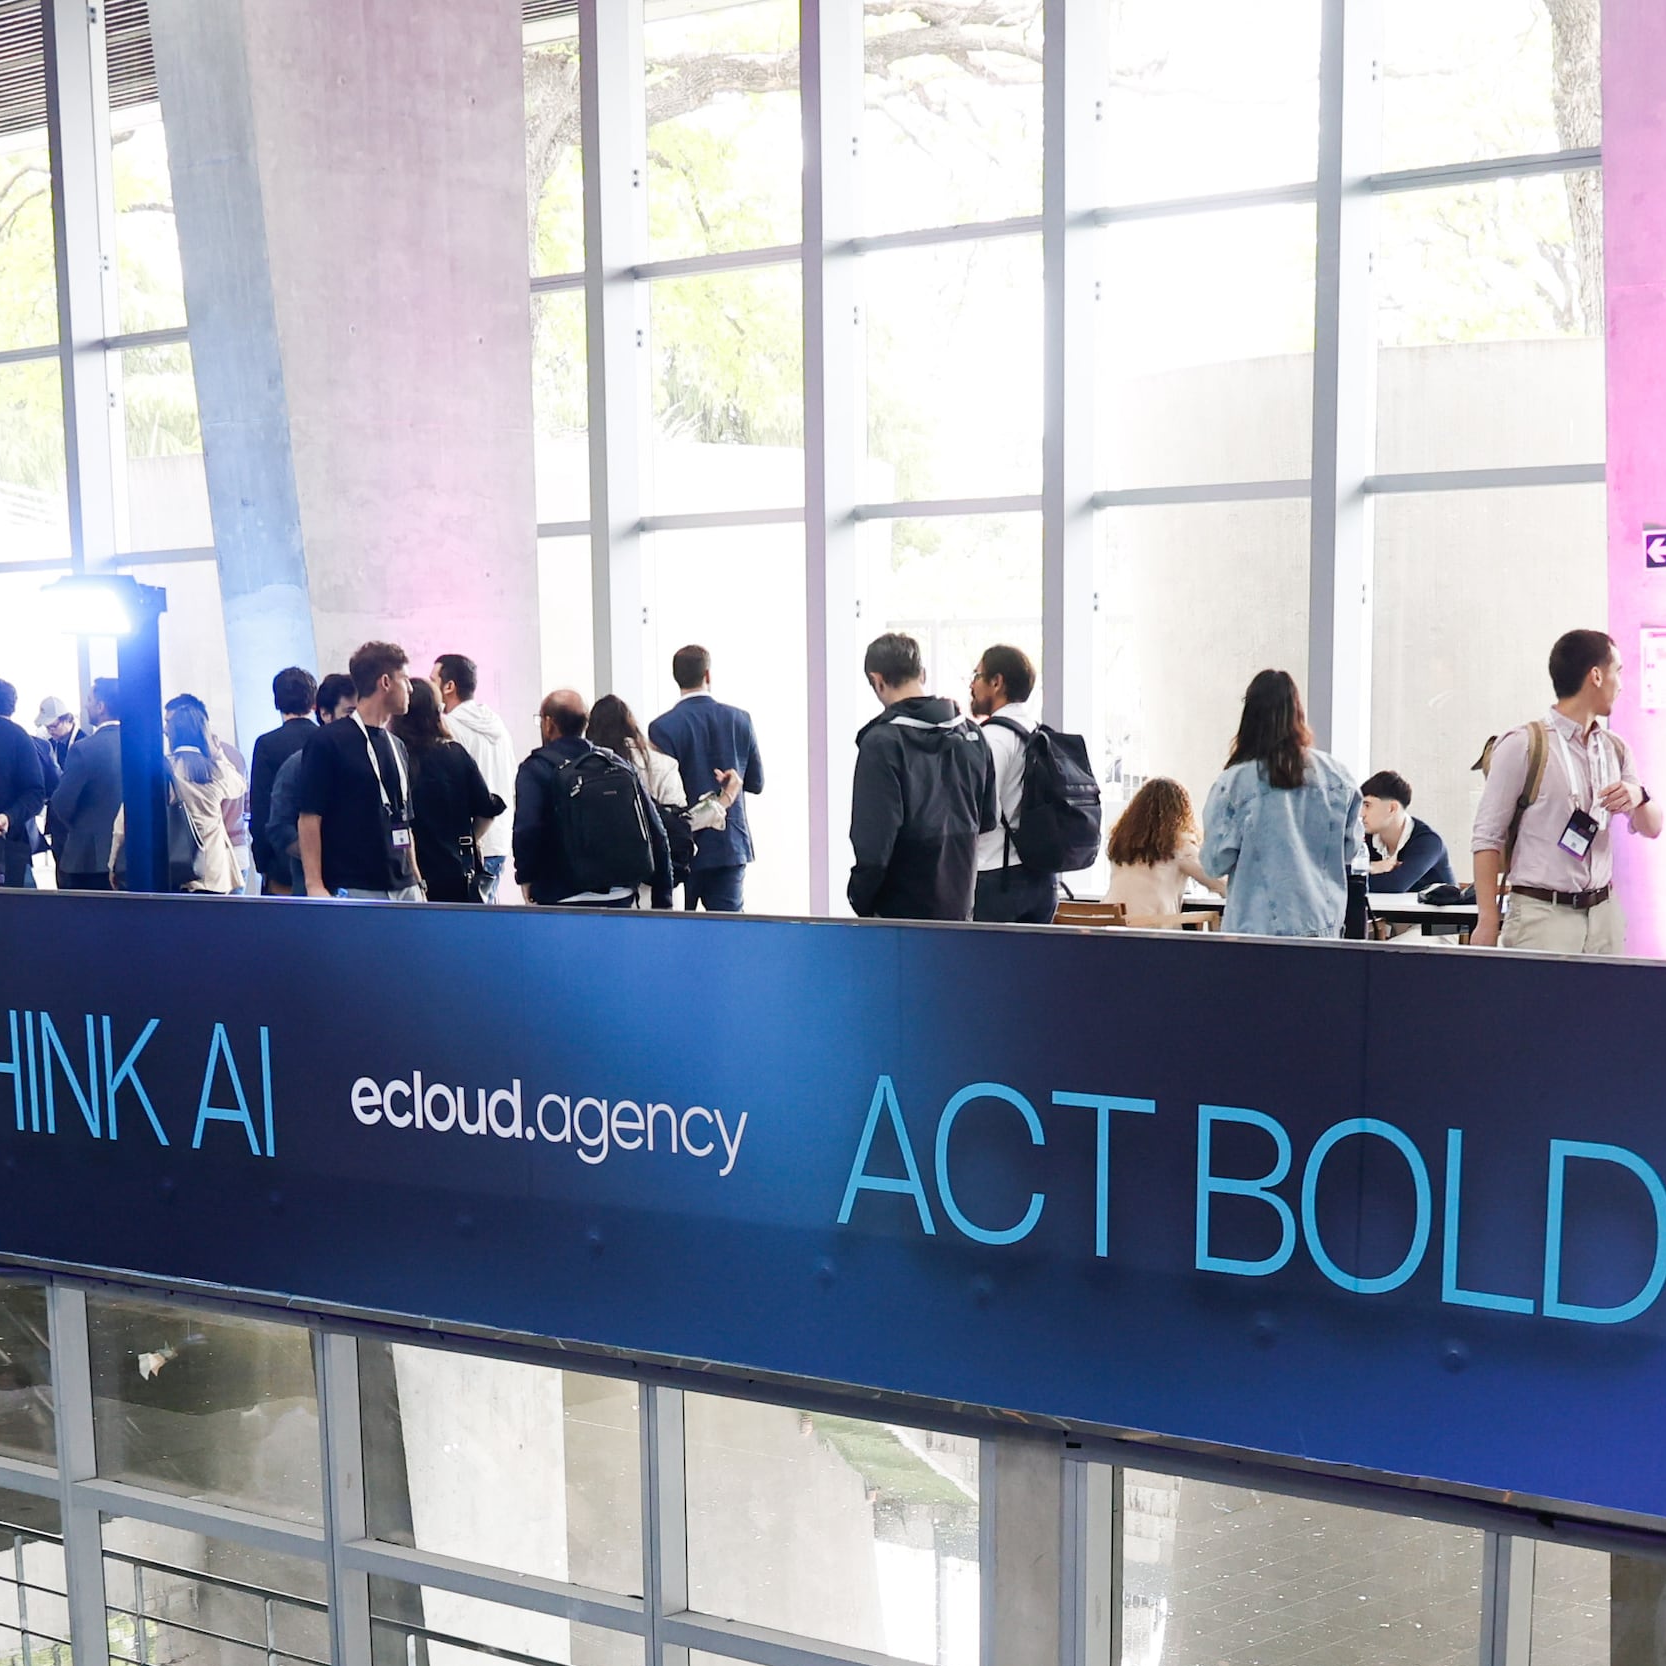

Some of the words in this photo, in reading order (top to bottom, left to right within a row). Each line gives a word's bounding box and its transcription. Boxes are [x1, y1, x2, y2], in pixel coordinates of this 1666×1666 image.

[193, 1022, 276, 1158] AI
[350, 1070, 749, 1177] ecloud.agency
[836, 1073, 1156, 1258] ACT
